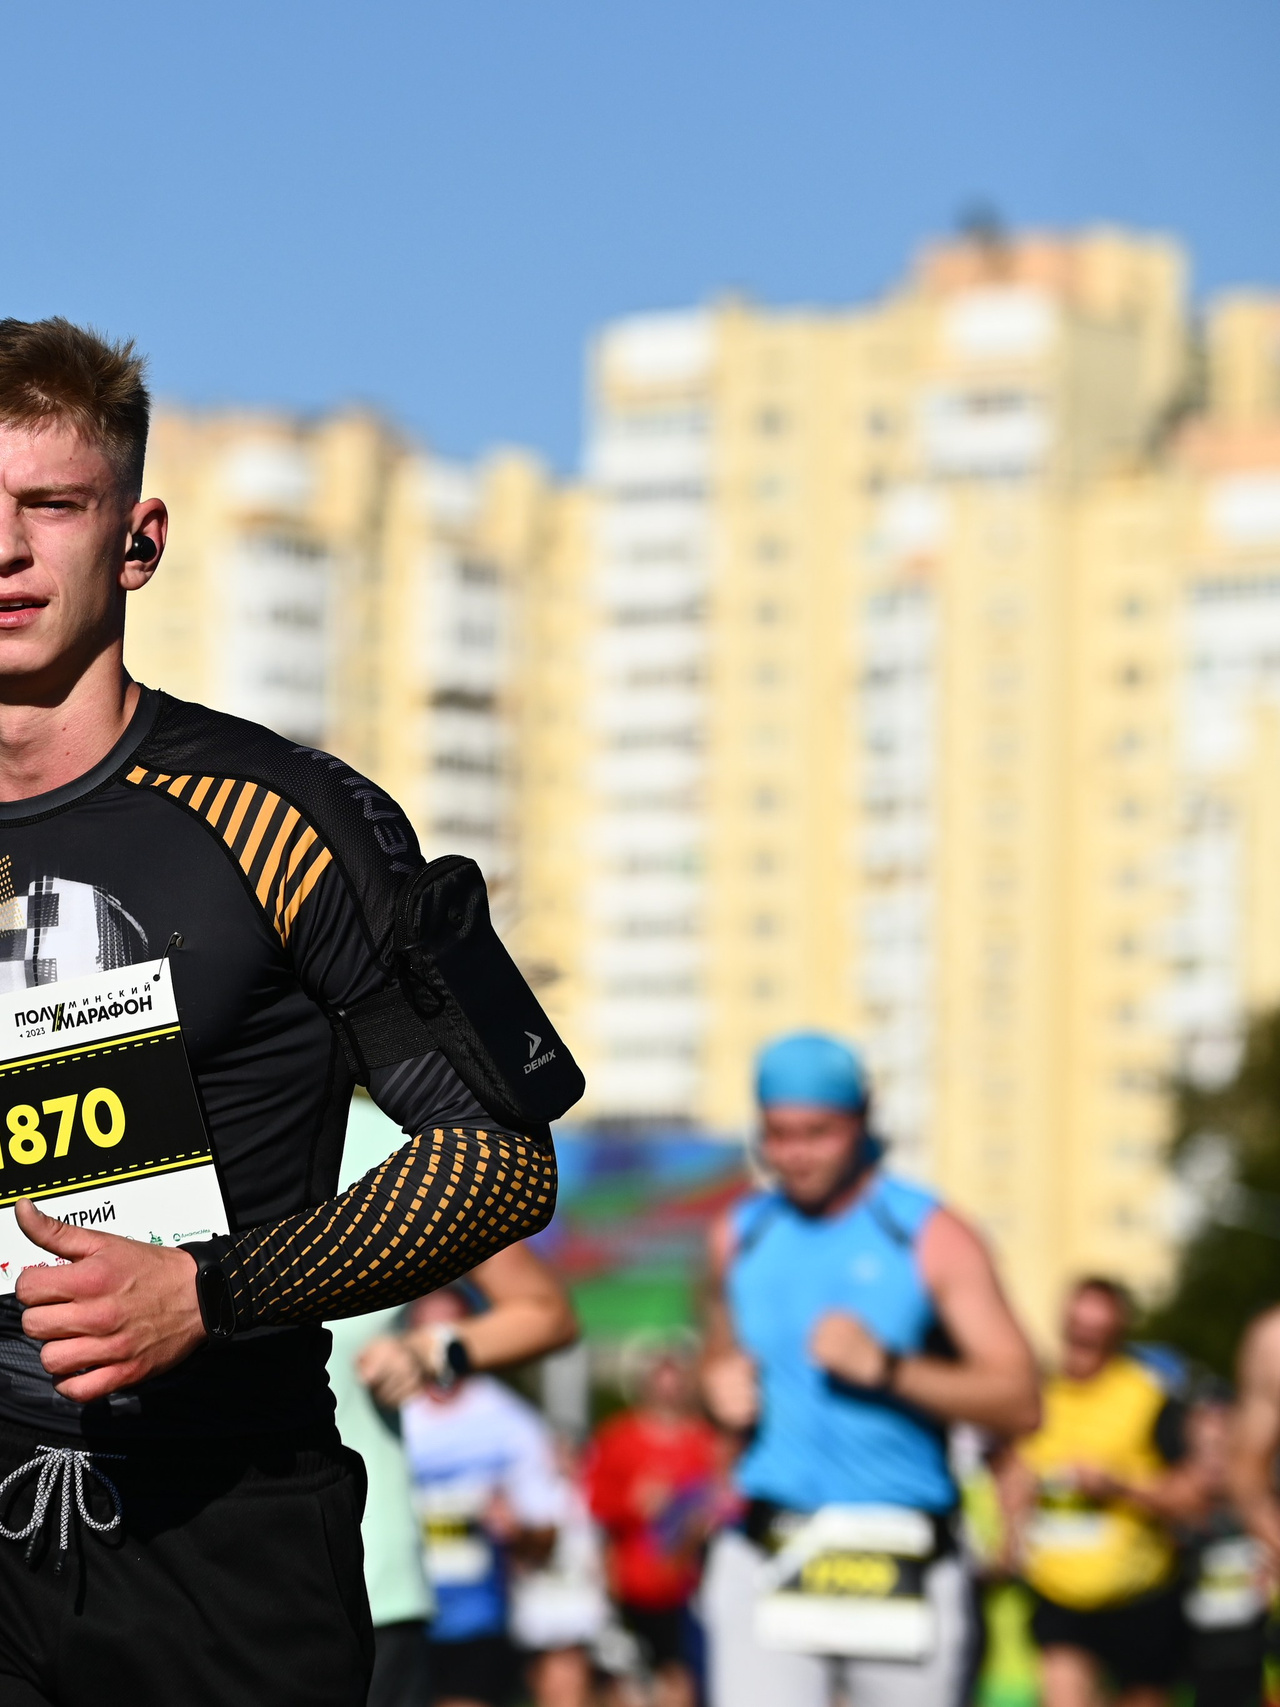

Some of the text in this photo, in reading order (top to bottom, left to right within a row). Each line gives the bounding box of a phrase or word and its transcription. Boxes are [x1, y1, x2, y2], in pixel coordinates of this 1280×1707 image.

[68, 982, 152, 1009] МИНСКИЙ
[25, 1027, 46, 1038] 2023
[523, 1049, 556, 1075] DEMIX
